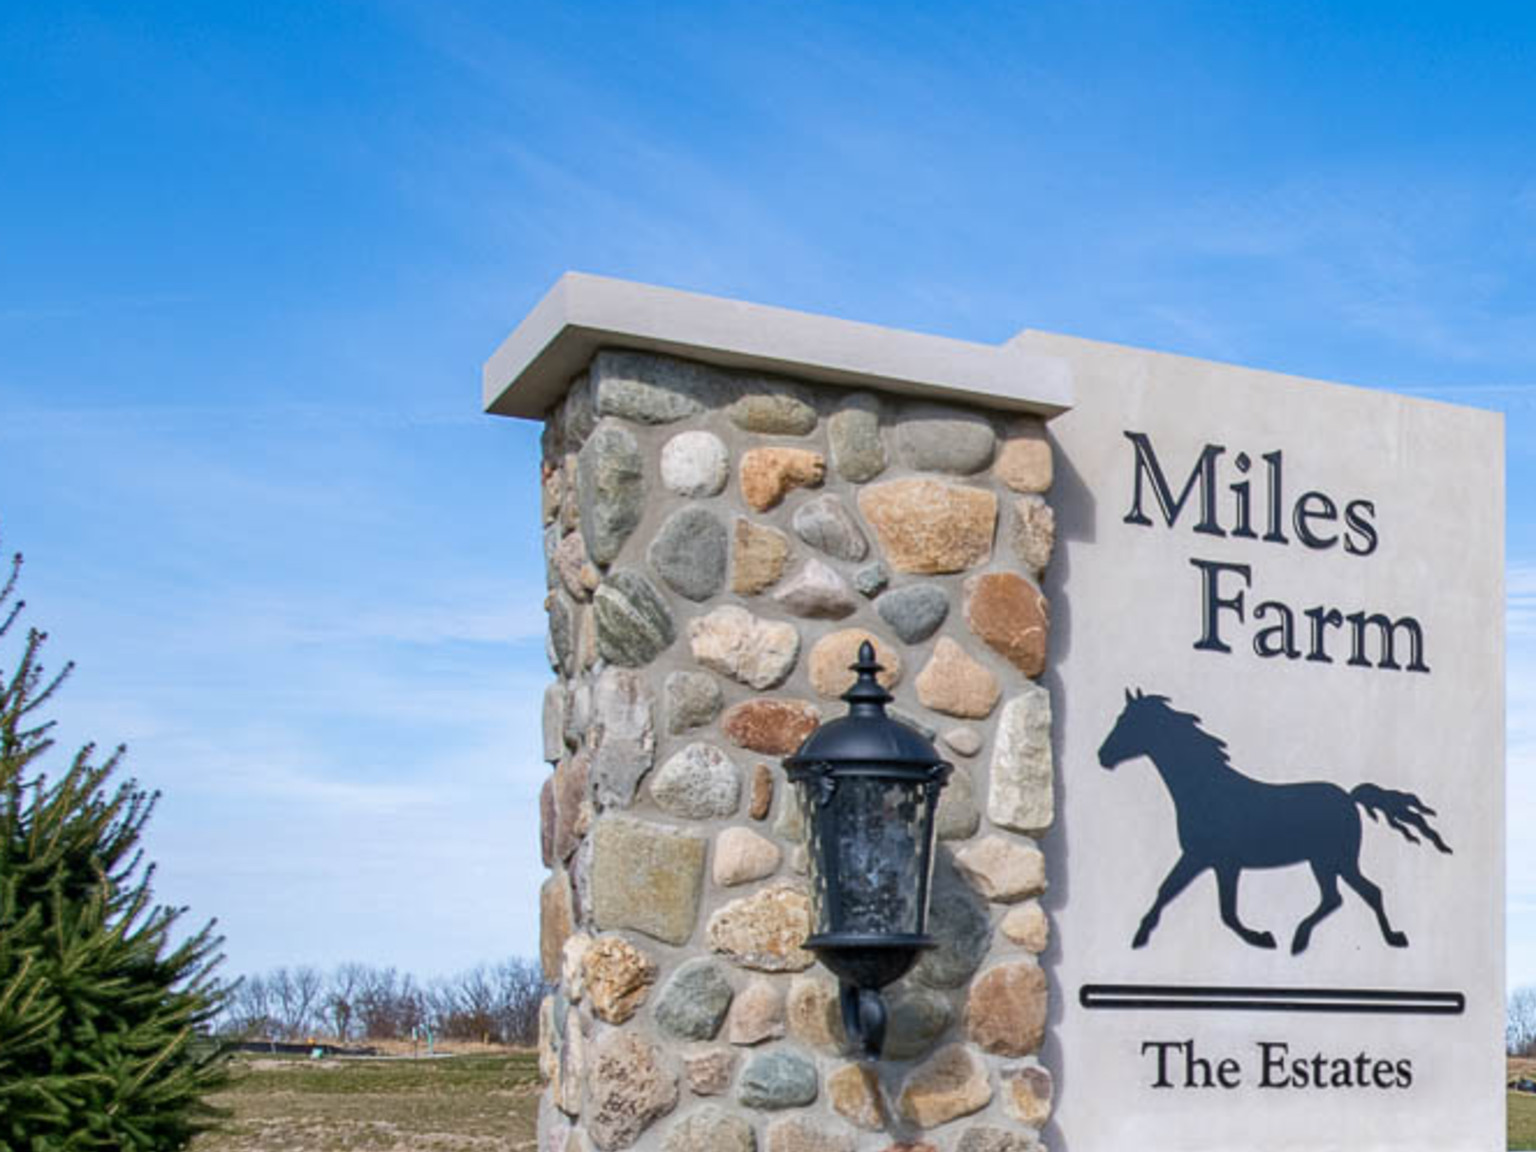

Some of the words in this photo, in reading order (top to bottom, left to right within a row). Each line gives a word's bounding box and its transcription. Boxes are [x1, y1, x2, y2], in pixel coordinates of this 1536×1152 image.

[1124, 431, 1378, 556] Miles
[1190, 558, 1430, 673] Farm
[1142, 1039, 1241, 1089] The
[1257, 1042, 1412, 1090] Estates
